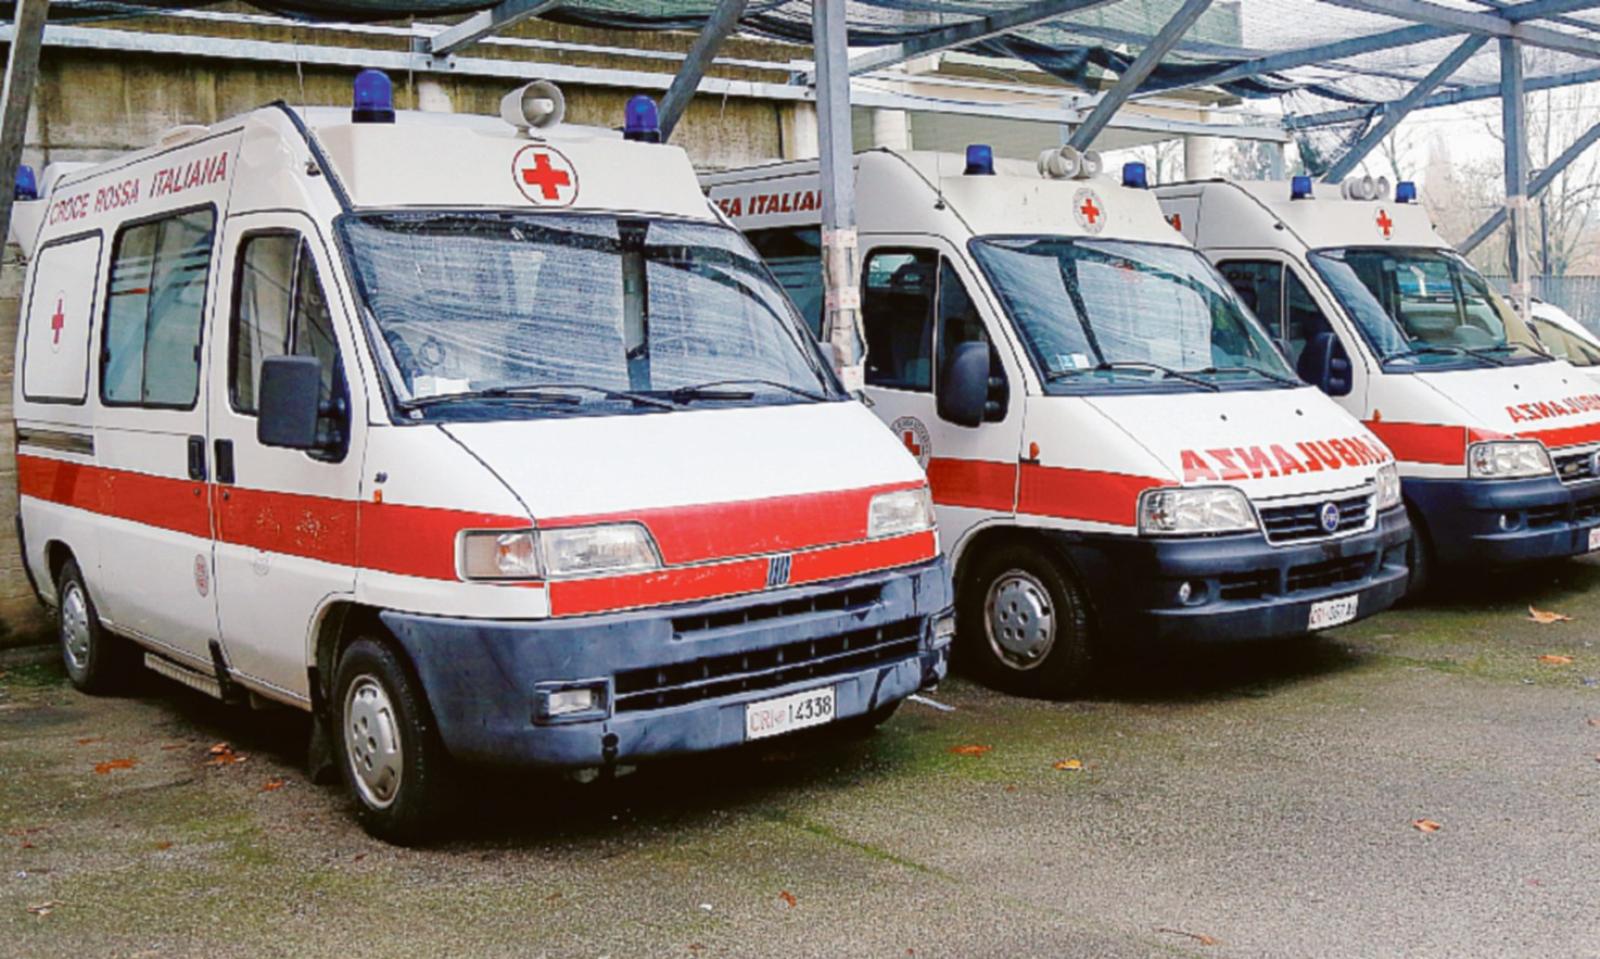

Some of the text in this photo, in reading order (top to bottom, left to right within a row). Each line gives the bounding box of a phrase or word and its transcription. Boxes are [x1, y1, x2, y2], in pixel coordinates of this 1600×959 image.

[49, 151, 228, 225] CROCE ROSSA ITALIANA
[788, 695, 833, 724] 14338
